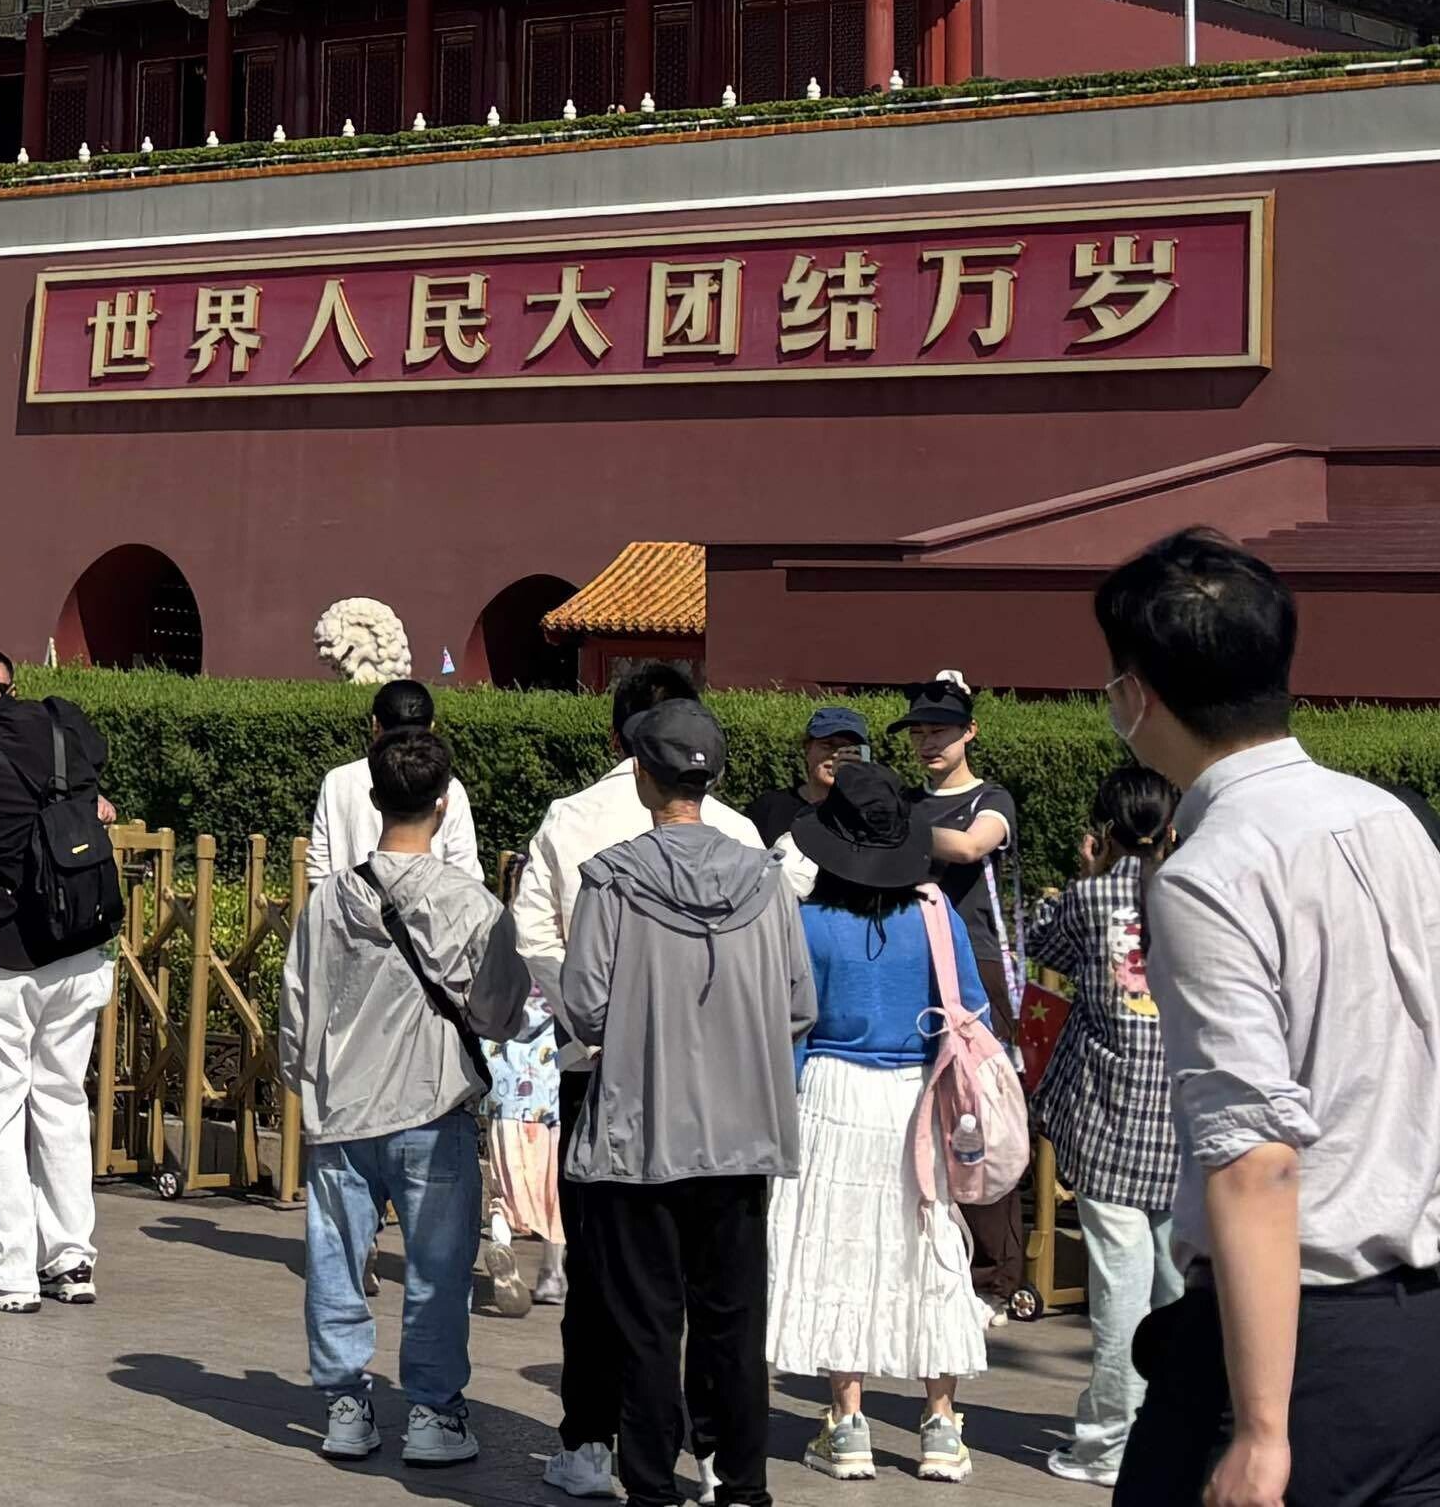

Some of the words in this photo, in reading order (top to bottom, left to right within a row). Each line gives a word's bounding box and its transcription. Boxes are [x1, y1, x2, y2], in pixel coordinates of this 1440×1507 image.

[87, 234, 1179, 380] 世界人民大团结万岁
